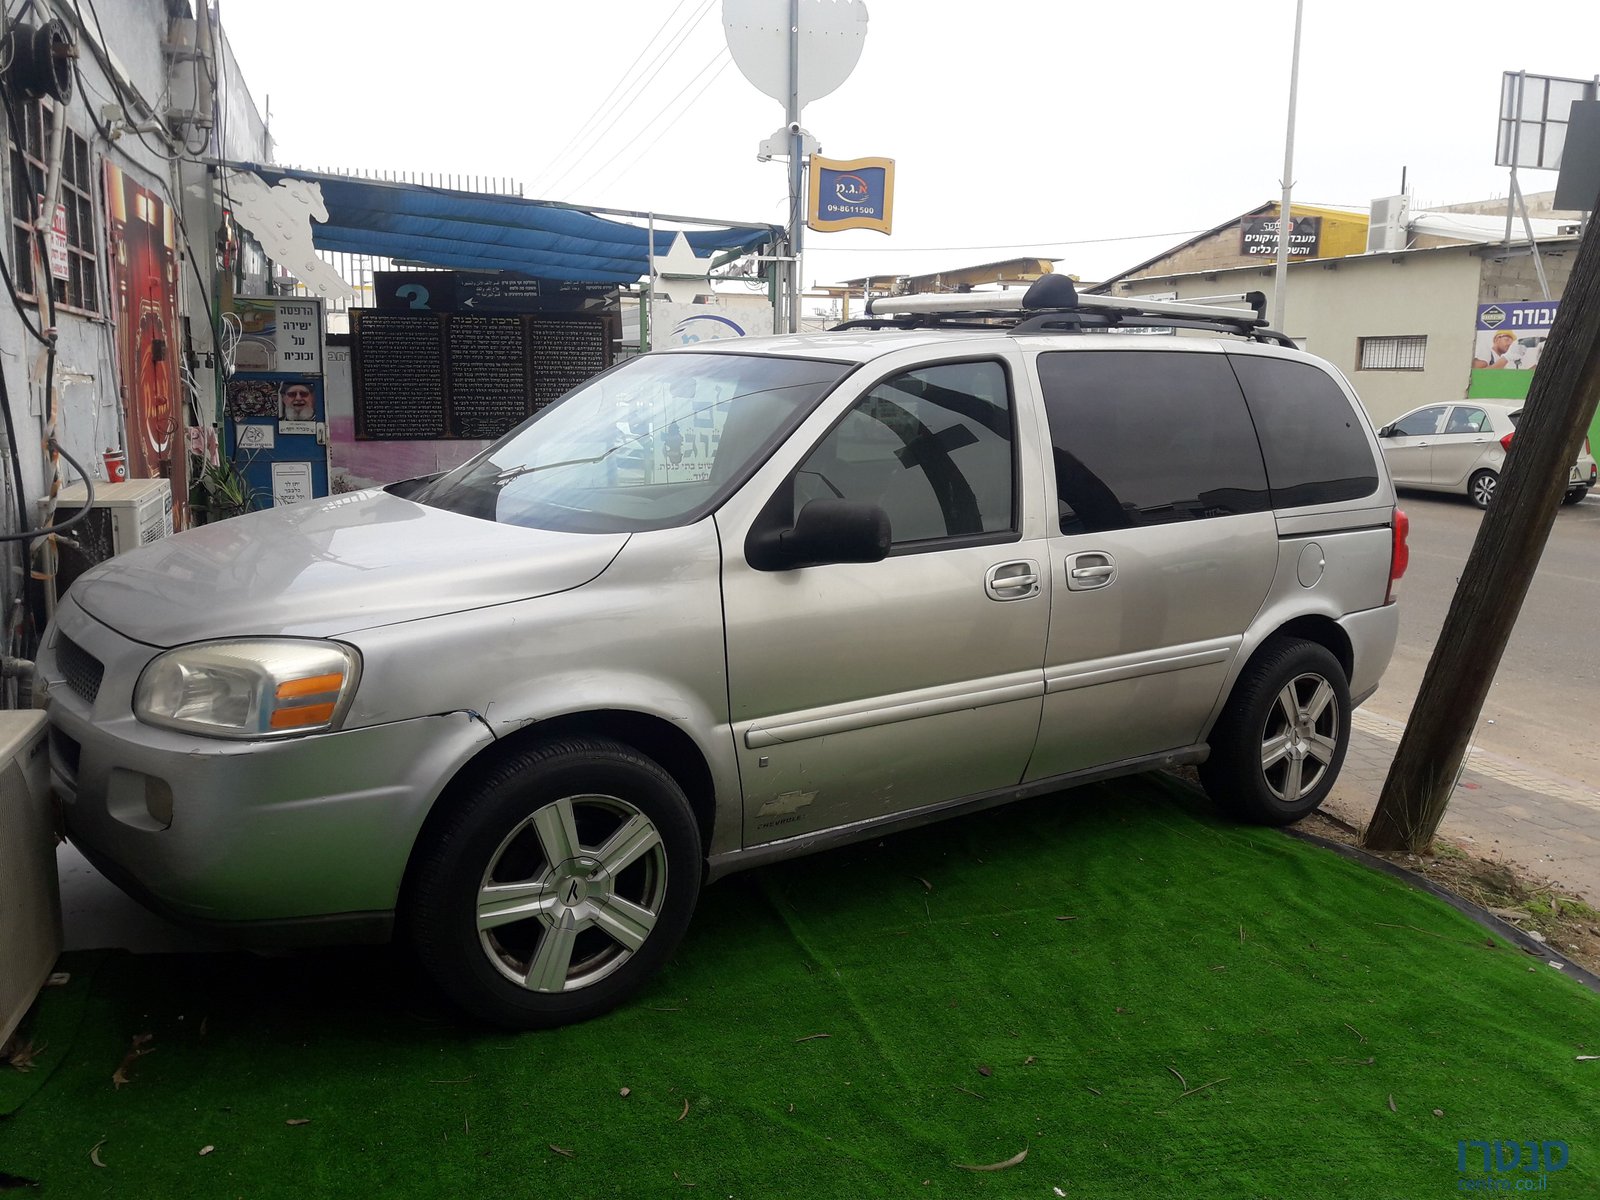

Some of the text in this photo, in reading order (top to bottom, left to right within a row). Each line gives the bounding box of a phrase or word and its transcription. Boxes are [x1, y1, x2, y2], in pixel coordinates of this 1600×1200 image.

[827, 204, 875, 214] 09-8611500
[1284, 235, 1316, 243] מעבד
[1249, 244, 1272, 254] כלים
[280, 306, 313, 316] הדפסה
[452, 314, 487, 324] הלבנה
[283, 321, 311, 331] ישירה
[291, 335, 305, 345] על
[284, 352, 314, 360] זכוכית
